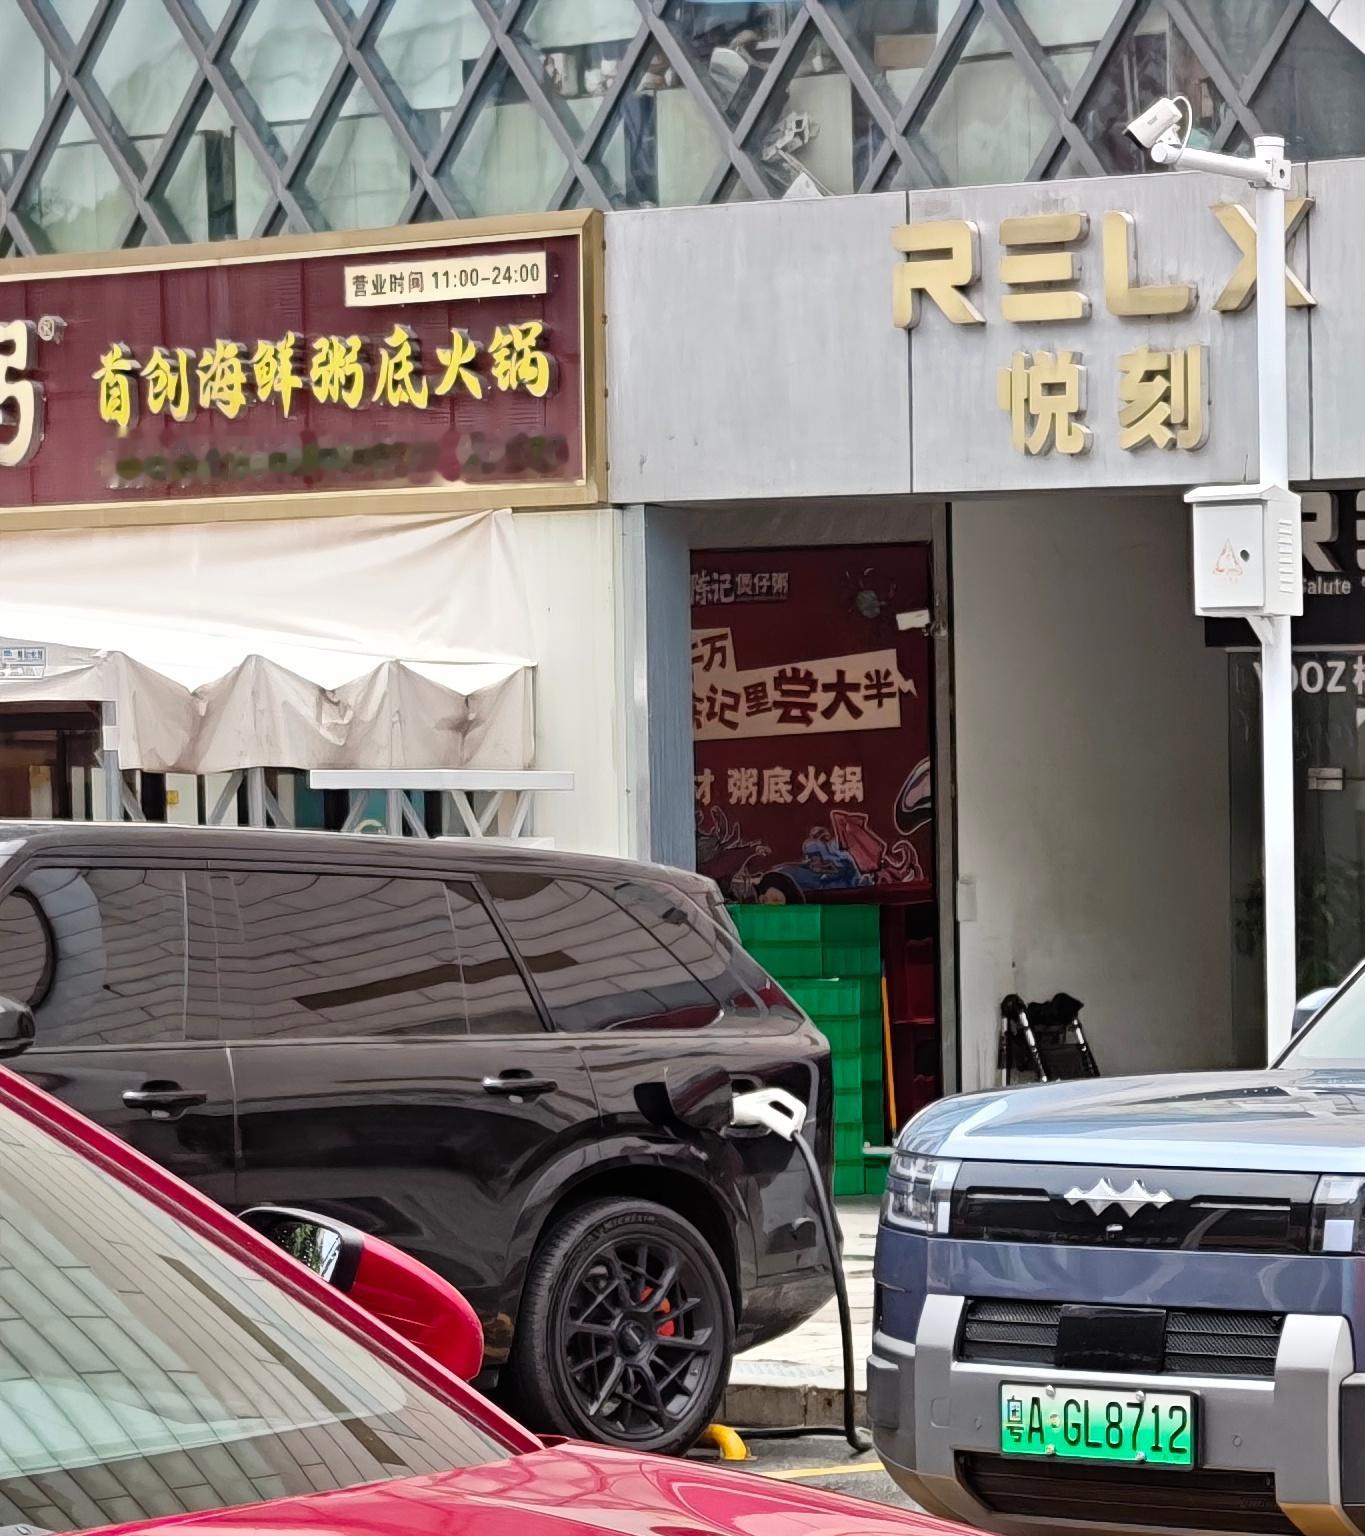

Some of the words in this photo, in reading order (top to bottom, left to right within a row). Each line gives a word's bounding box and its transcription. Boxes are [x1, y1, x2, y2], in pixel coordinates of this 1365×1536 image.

[352, 271, 425, 298] 营业时间
[431, 263, 540, 290] 11:00-24:00
[891, 197, 1317, 328] RELX
[92, 320, 552, 428] 首创海鲜粥底火锅
[997, 344, 1213, 456] 悦刻
[727, 765, 865, 806] 粥底火锅
